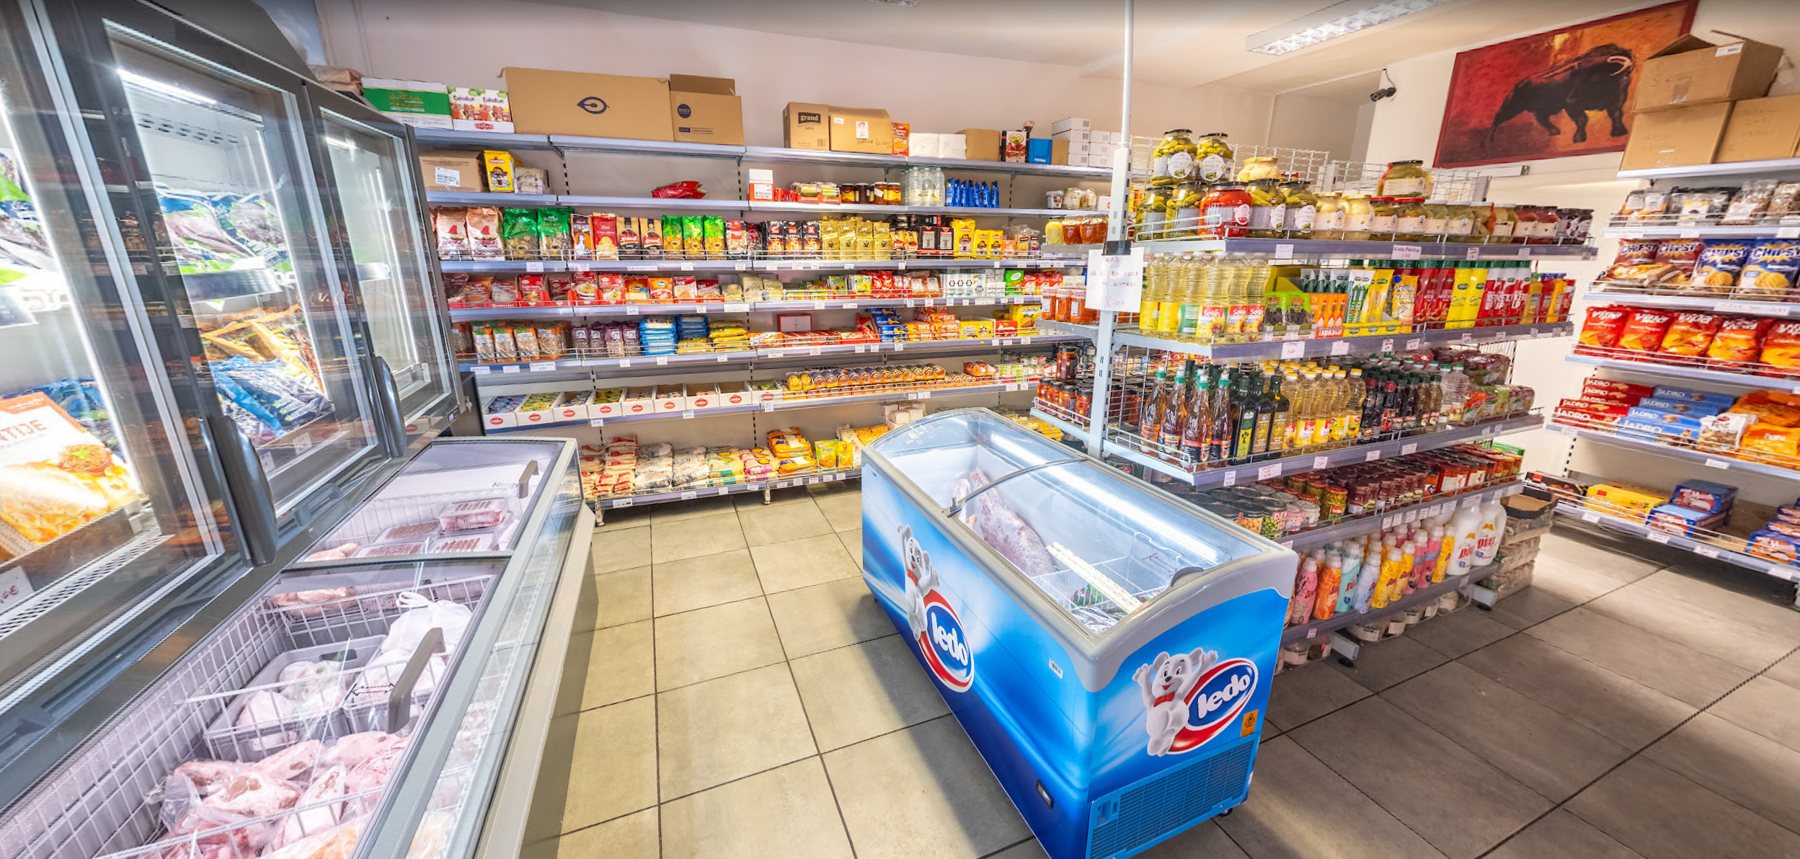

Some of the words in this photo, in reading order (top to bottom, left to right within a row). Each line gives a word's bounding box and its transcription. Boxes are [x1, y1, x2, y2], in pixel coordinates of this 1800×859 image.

[1624, 420, 1663, 433] JADRO
[931, 612, 968, 666] ledo
[1198, 674, 1251, 719] ledo
